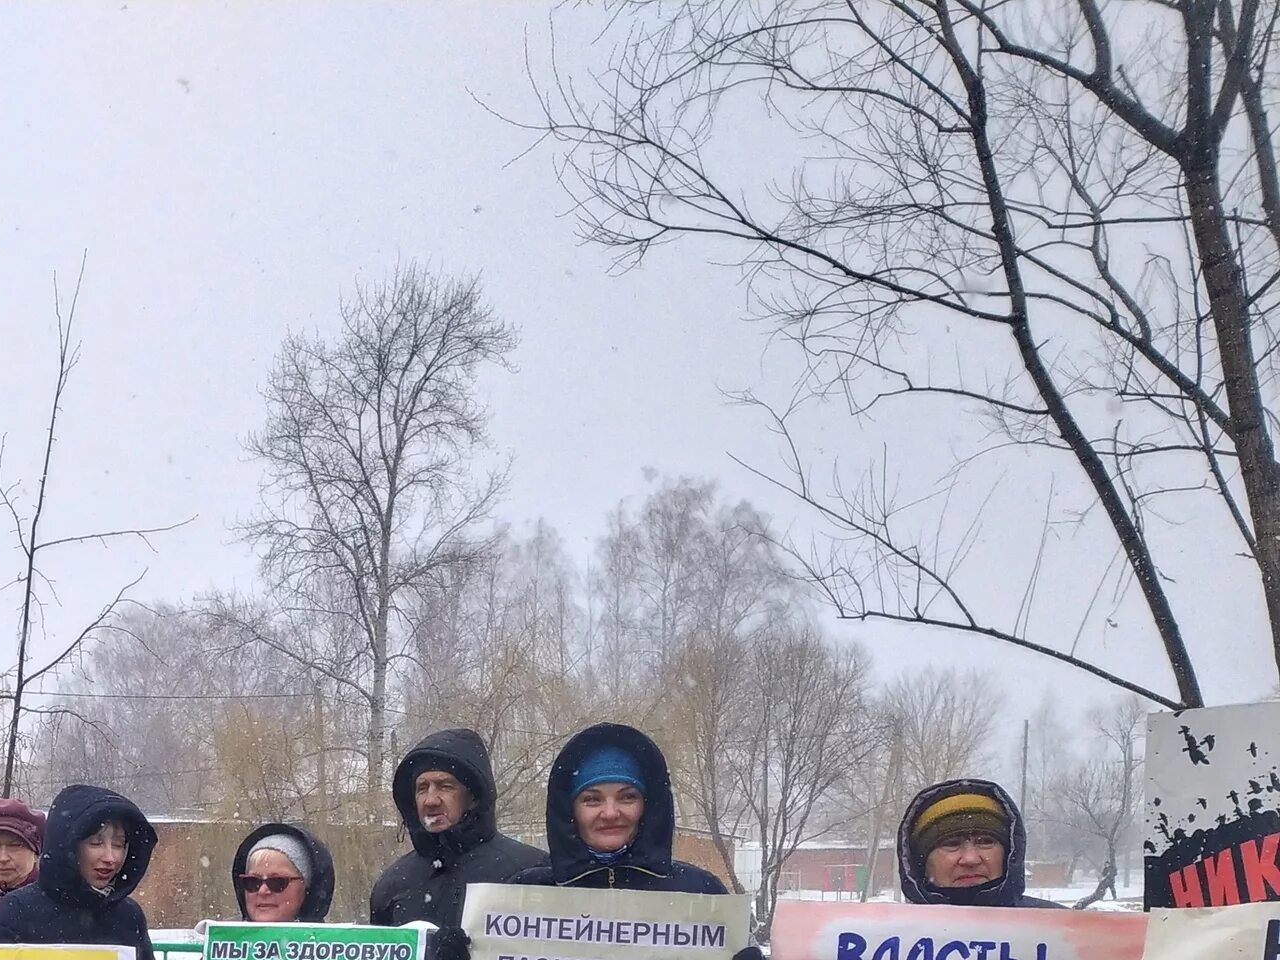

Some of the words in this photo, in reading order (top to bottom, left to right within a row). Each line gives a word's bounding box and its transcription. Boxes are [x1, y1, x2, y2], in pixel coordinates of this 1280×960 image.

[485, 914, 725, 947] КОНТЕЙНЕРНЫМ
[212, 942, 247, 959] МЫ
[254, 943, 280, 960] ЗА
